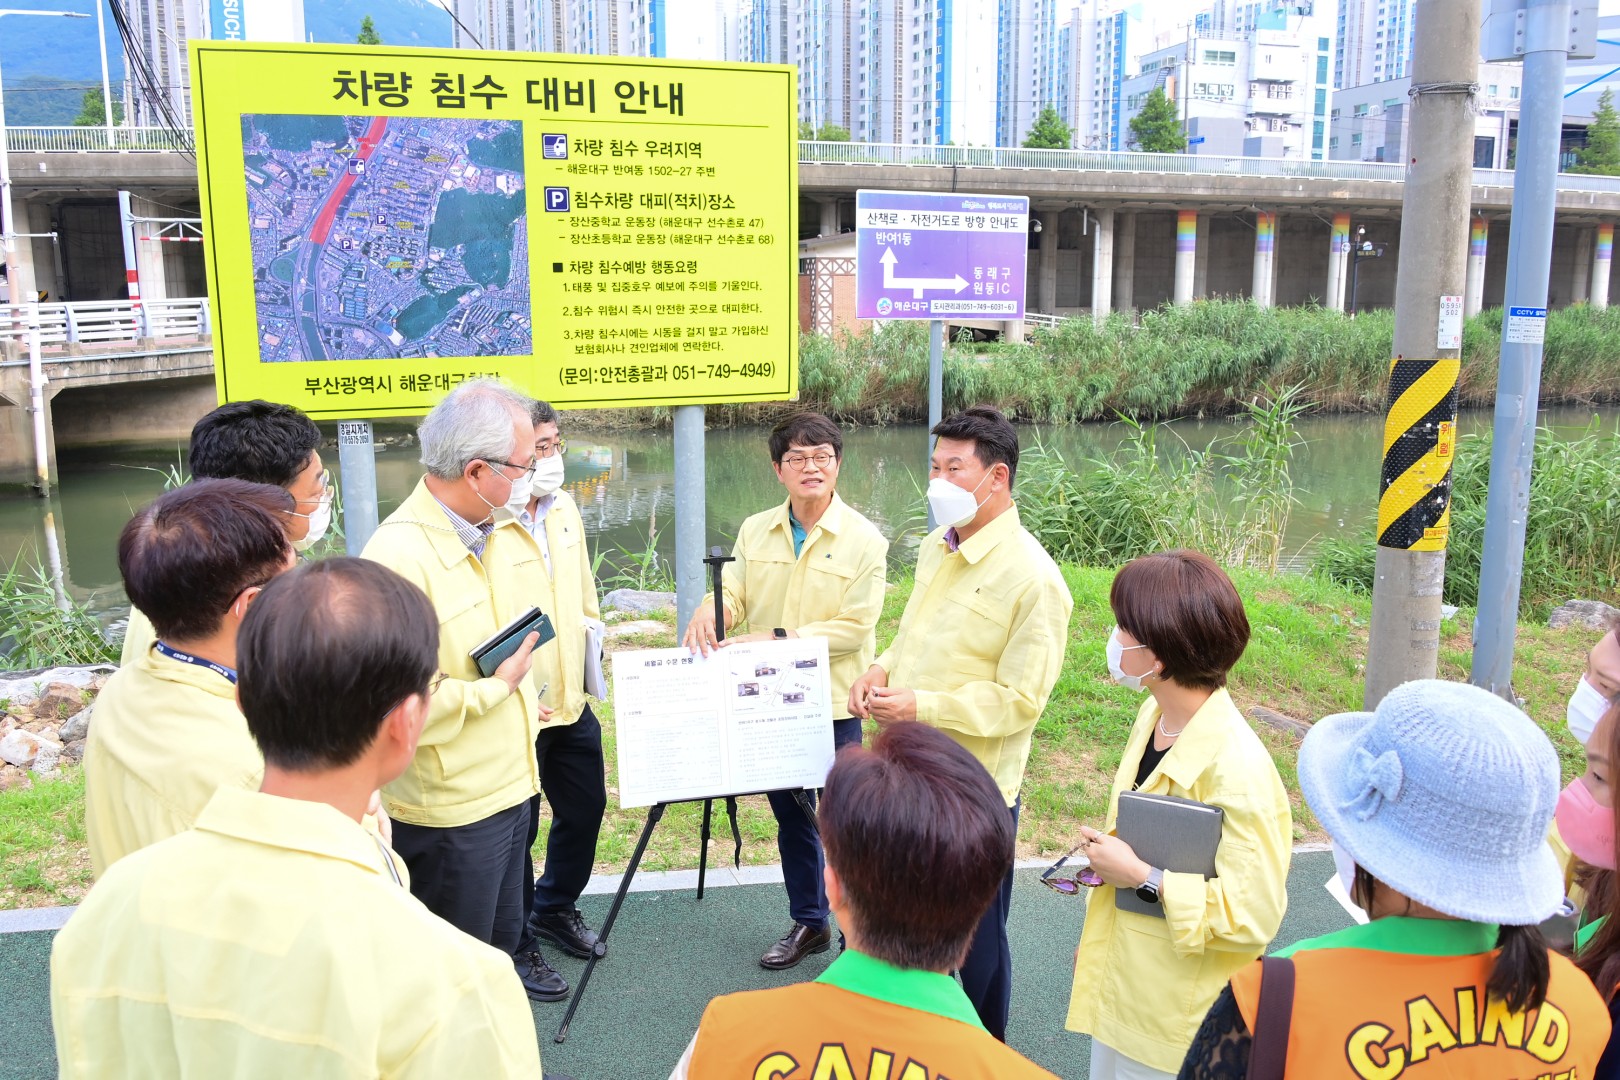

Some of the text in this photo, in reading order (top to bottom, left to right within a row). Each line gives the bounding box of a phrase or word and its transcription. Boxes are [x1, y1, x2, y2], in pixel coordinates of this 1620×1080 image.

[333, 70, 683, 116] 차량 침수 대비 안내
[575, 139, 701, 158] 차량 침수 우려지역
[568, 164, 714, 176] 해운대구 반여동 1502-27 주변
[575, 192, 735, 210] 침수차량 대피(적치)장소
[570, 217, 763, 228] 장산중학교 운동장 (해운대구 선수촌로 47)
[868, 212, 1018, 228] 산책로 자전거도로 방향 안내도
[571, 234, 773, 244] 장산초등학교 운동장 (해운대구 선수촌로 68)
[876, 232, 912, 245] 반여1동
[570, 261, 696, 274] 차량 침수예방 행동요령
[598, 283, 606, 292] 및
[612, 282, 650, 292] 집중호우
[656, 282, 684, 291] 예보에
[689, 282, 716, 291] 주의를
[722, 281, 761, 291] 기울인다.
[598, 306, 627, 315] 위험시
[632, 306, 651, 315] 즉시
[656, 305, 685, 314] 안전한
[689, 305, 717, 314] 곳으로
[722, 304, 761, 313] 대피한다.
[894, 301, 928, 311] 해운대구
[599, 329, 648, 339] 침수시에는
[653, 328, 681, 337] 시동을
[687, 327, 704, 337] 걸지
[709, 327, 727, 336] 말고
[732, 326, 768, 335] 가입하신
[575, 342, 723, 354] 보험회사나 견인업체에 연락한다.
[560, 362, 775, 385] (문의:안전총괄과 051-749-4949)
[305, 372, 501, 395] 부산광역시 해운대구
[1345, 985, 1570, 1080] CAIND
